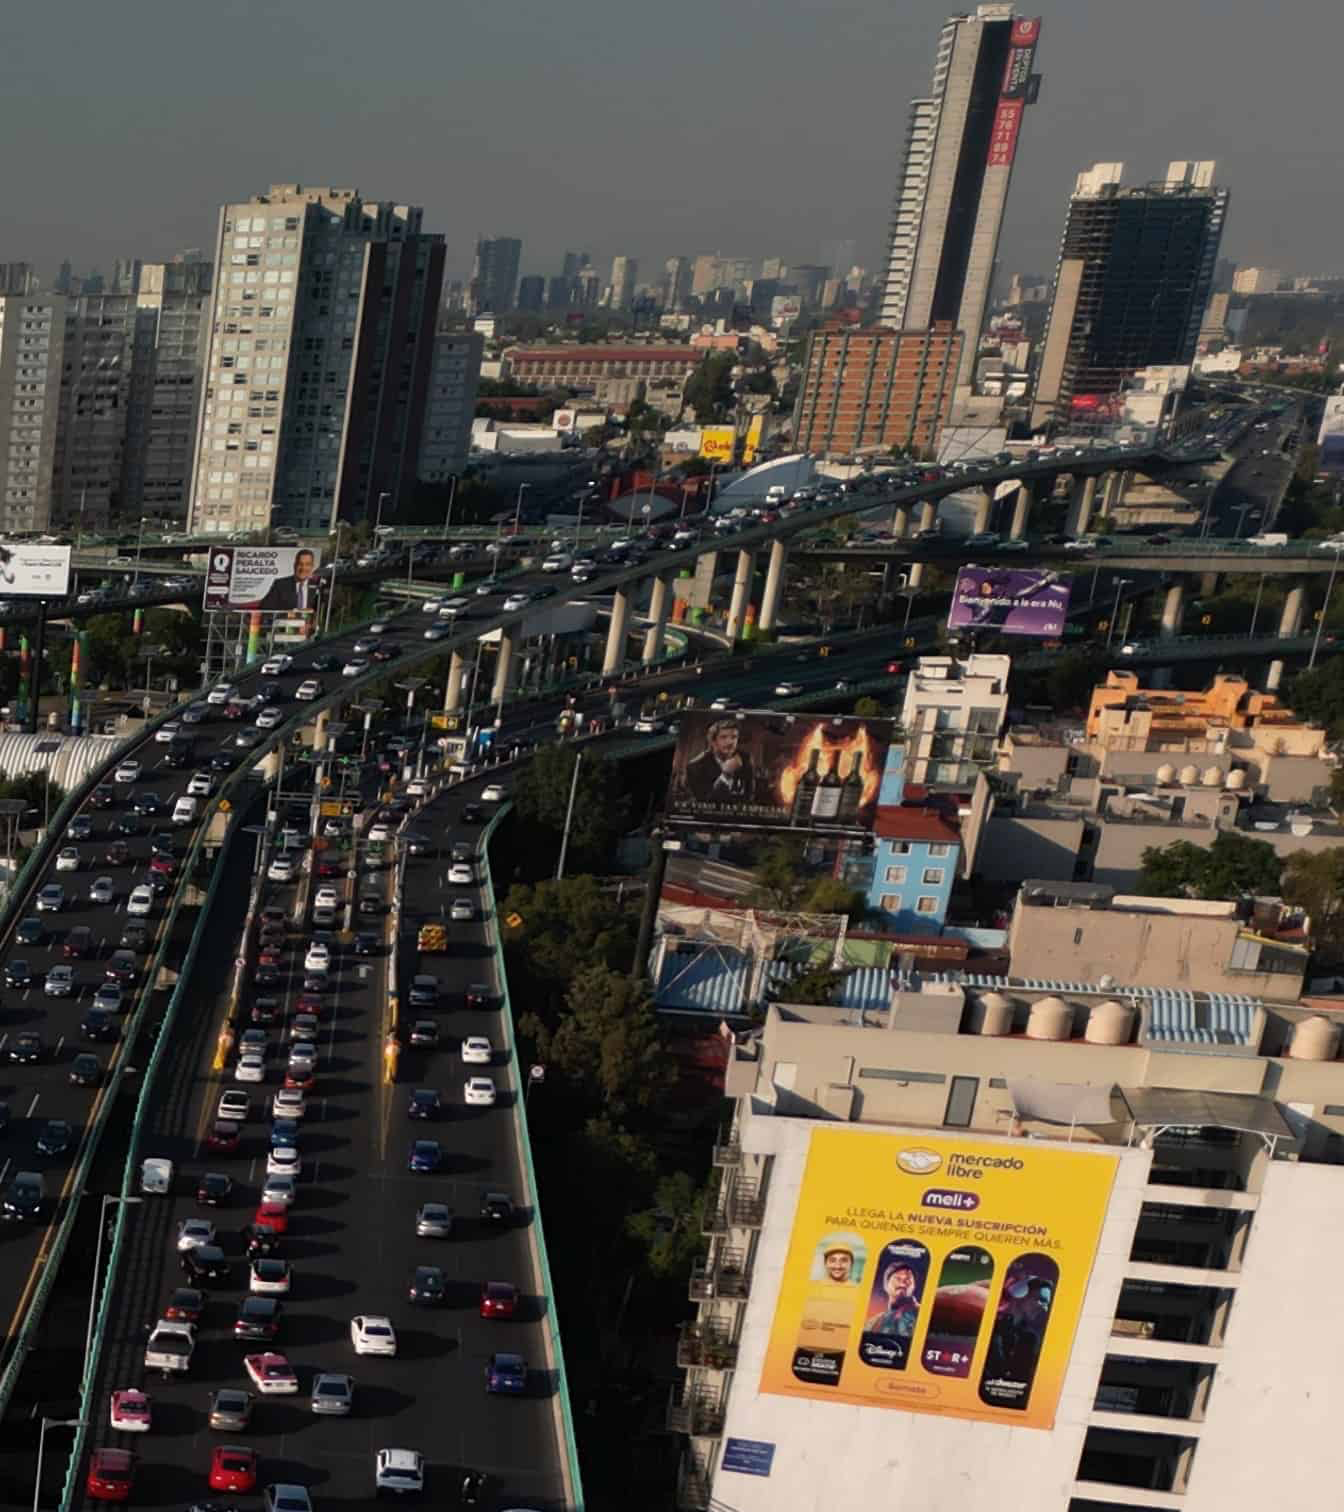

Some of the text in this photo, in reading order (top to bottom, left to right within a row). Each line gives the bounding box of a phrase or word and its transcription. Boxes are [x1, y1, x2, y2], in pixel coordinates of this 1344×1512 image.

[236, 551, 278, 559] RICARDO
[236, 559, 275, 567] PERALTA
[949, 1152, 1024, 1170] mercado
[946, 1165, 984, 1180] libre
[847, 1207, 886, 1220] LLEGA
[889, 1211, 904, 1222] LA
[908, 1213, 953, 1227] NUEVA
[825, 1216, 858, 1228] PARA
[860, 1220, 915, 1234] QUIENES
[918, 1226, 970, 1240] SIEMPRE
[974, 1231, 1031, 1247] QUIEREN
